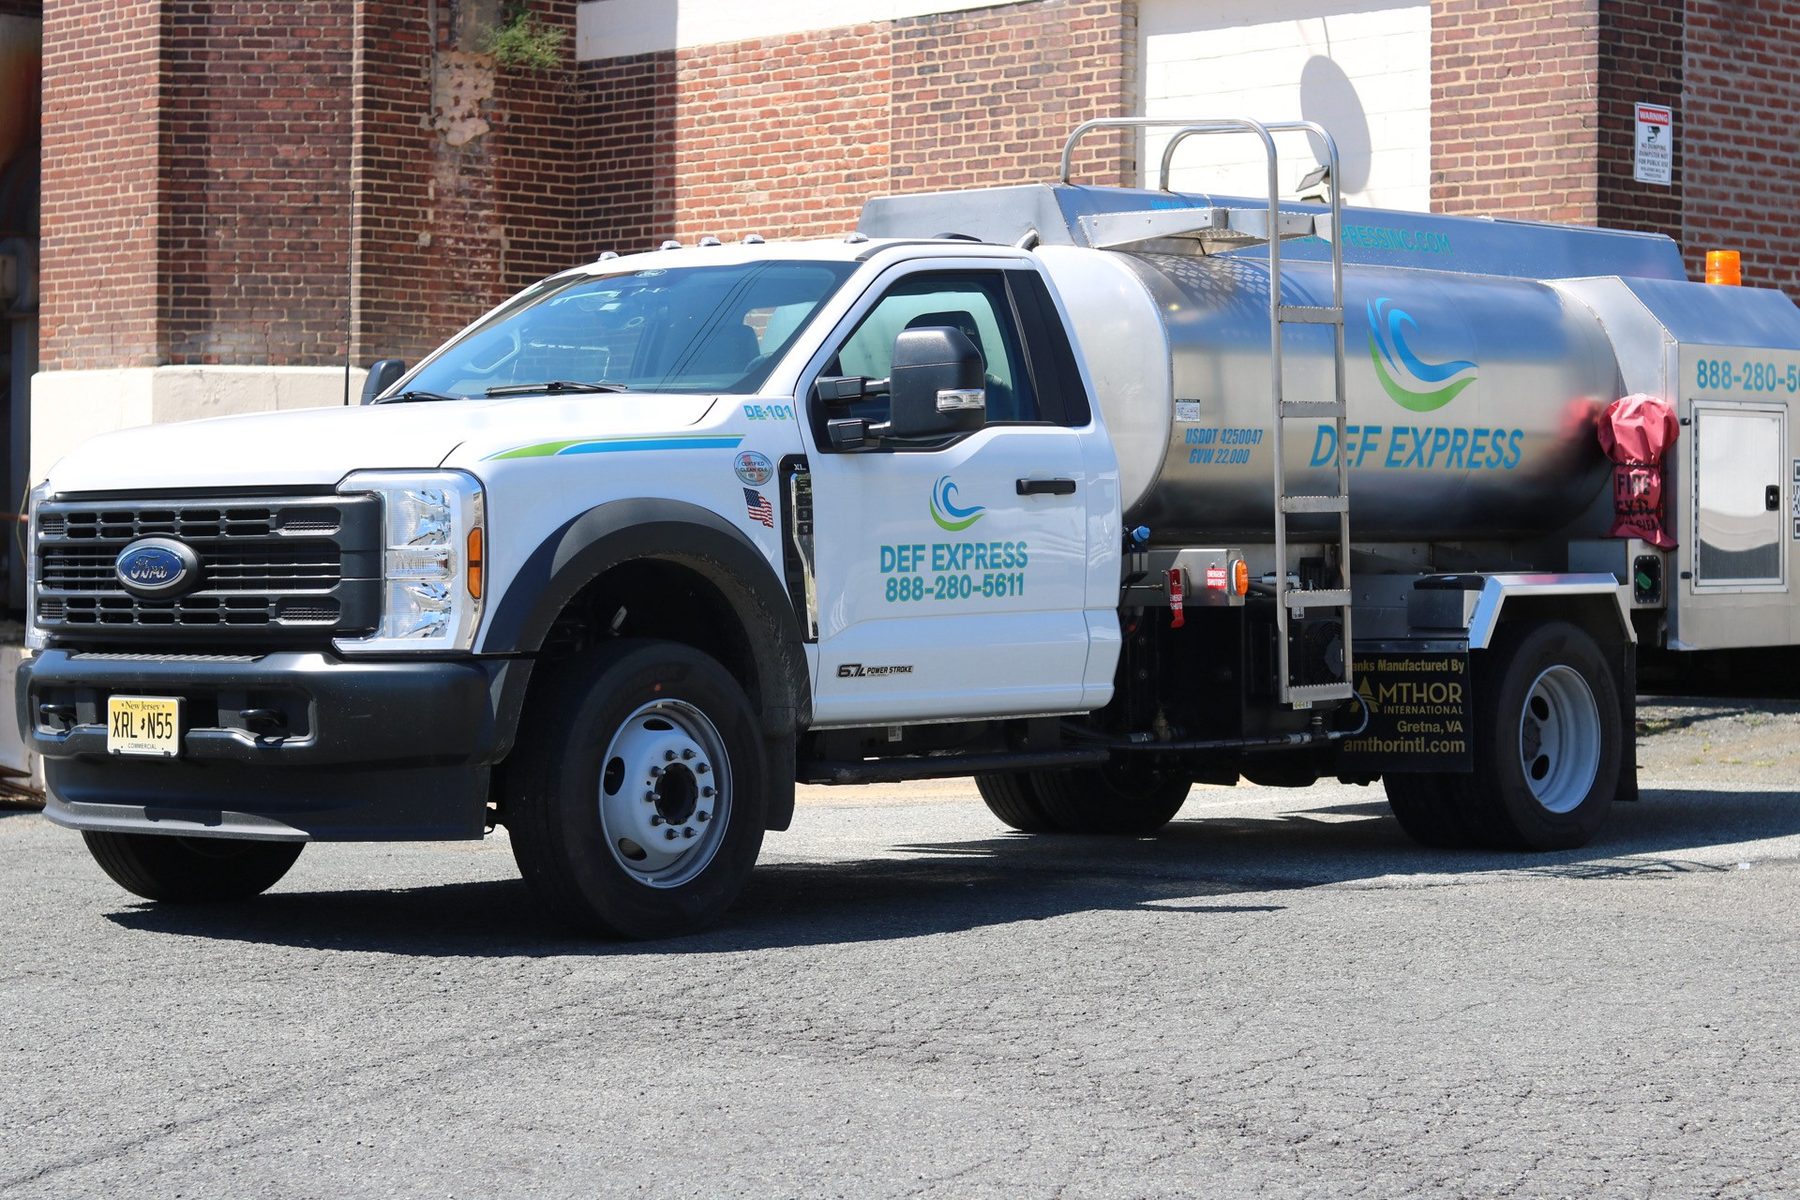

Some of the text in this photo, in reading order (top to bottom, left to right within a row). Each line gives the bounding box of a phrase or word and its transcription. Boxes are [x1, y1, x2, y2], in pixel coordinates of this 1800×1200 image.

[1697, 359, 1800, 392] 888-280-5
[1185, 428, 1263, 445] USDOT 4250047
[1310, 425, 1524, 470] DEF EXPRESS
[1189, 448, 1250, 464] GVW 22,000
[793, 463, 806, 471] XL
[880, 541, 1028, 573] DEF EXPRESS
[131, 555, 168, 579] Ford
[885, 572, 1024, 602] 888-280-5611
[889, 665, 912, 673] STROKE
[1350, 659, 1464, 674] anks Manufactured By
[126, 701, 160, 711] New Jersey
[1384, 705, 1463, 714] INTERNATIONAL
[1397, 720, 1463, 734] Gretna, VA
[1344, 737, 1466, 753] amthorintl.com
